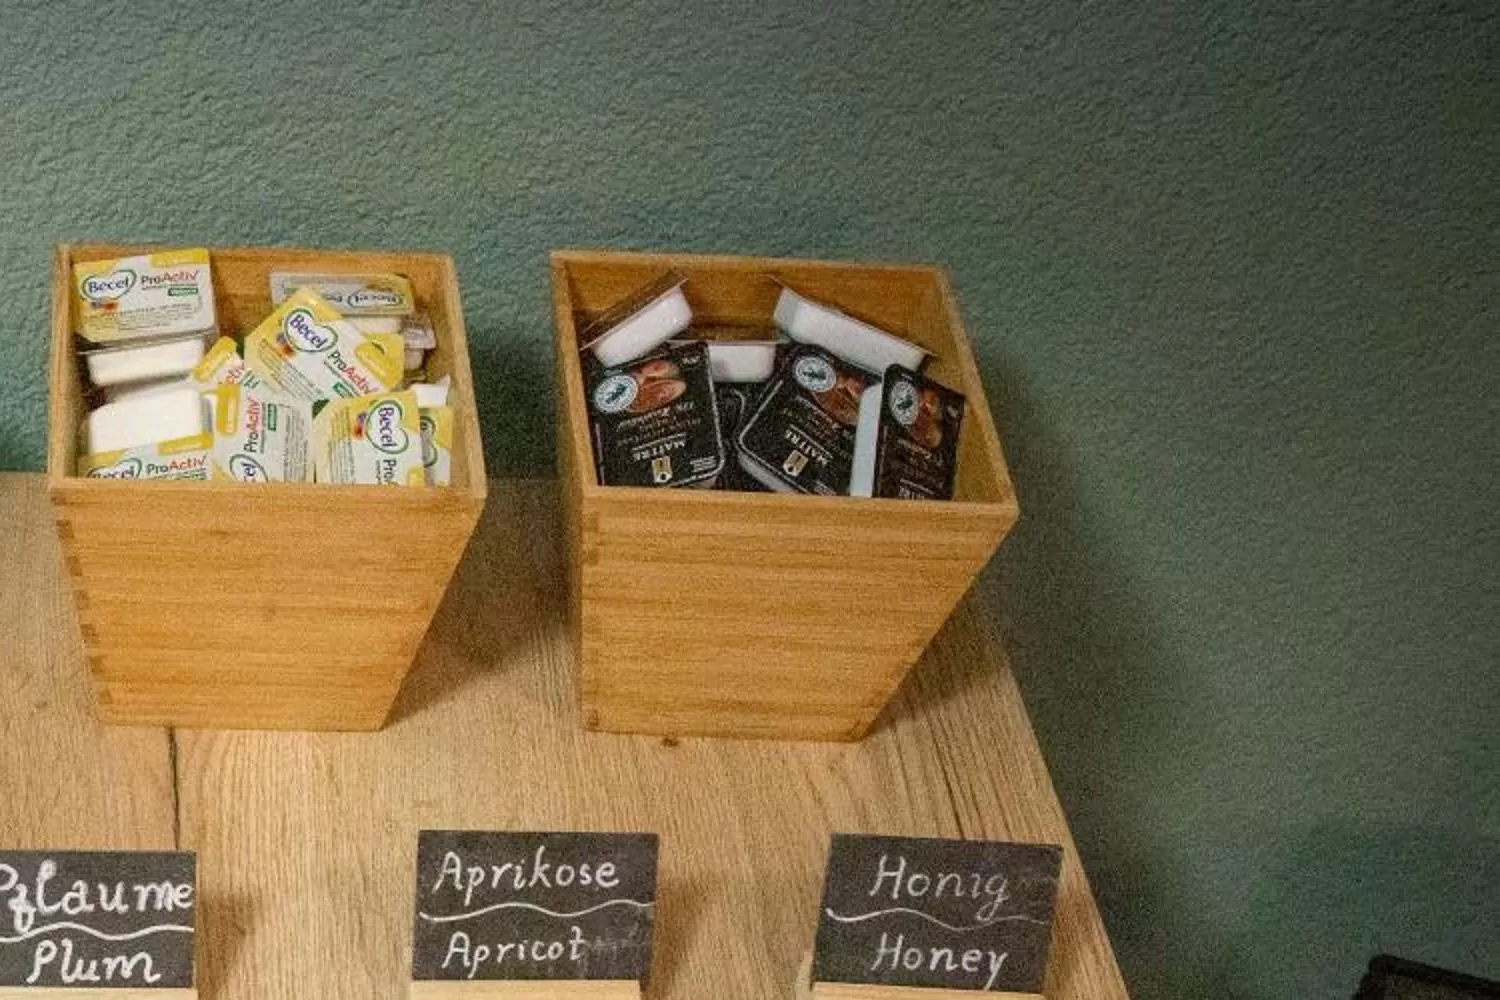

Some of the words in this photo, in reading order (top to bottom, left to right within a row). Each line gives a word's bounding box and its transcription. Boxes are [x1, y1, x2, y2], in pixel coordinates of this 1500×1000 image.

[88, 276, 130, 294] Becel
[141, 269, 199, 286] ProActiv
[290, 313, 329, 349] Becel
[328, 350, 378, 395] ProActiv
[243, 396, 260, 453] ProActiv
[378, 406, 399, 448] Becel
[146, 452, 208, 475] ProActiv
[431, 845, 620, 907] Aprikose
[869, 854, 1009, 921] Honig
[26, 938, 162, 984] Plum
[441, 925, 586, 979] Apricot
[870, 932, 1009, 991] Honey
